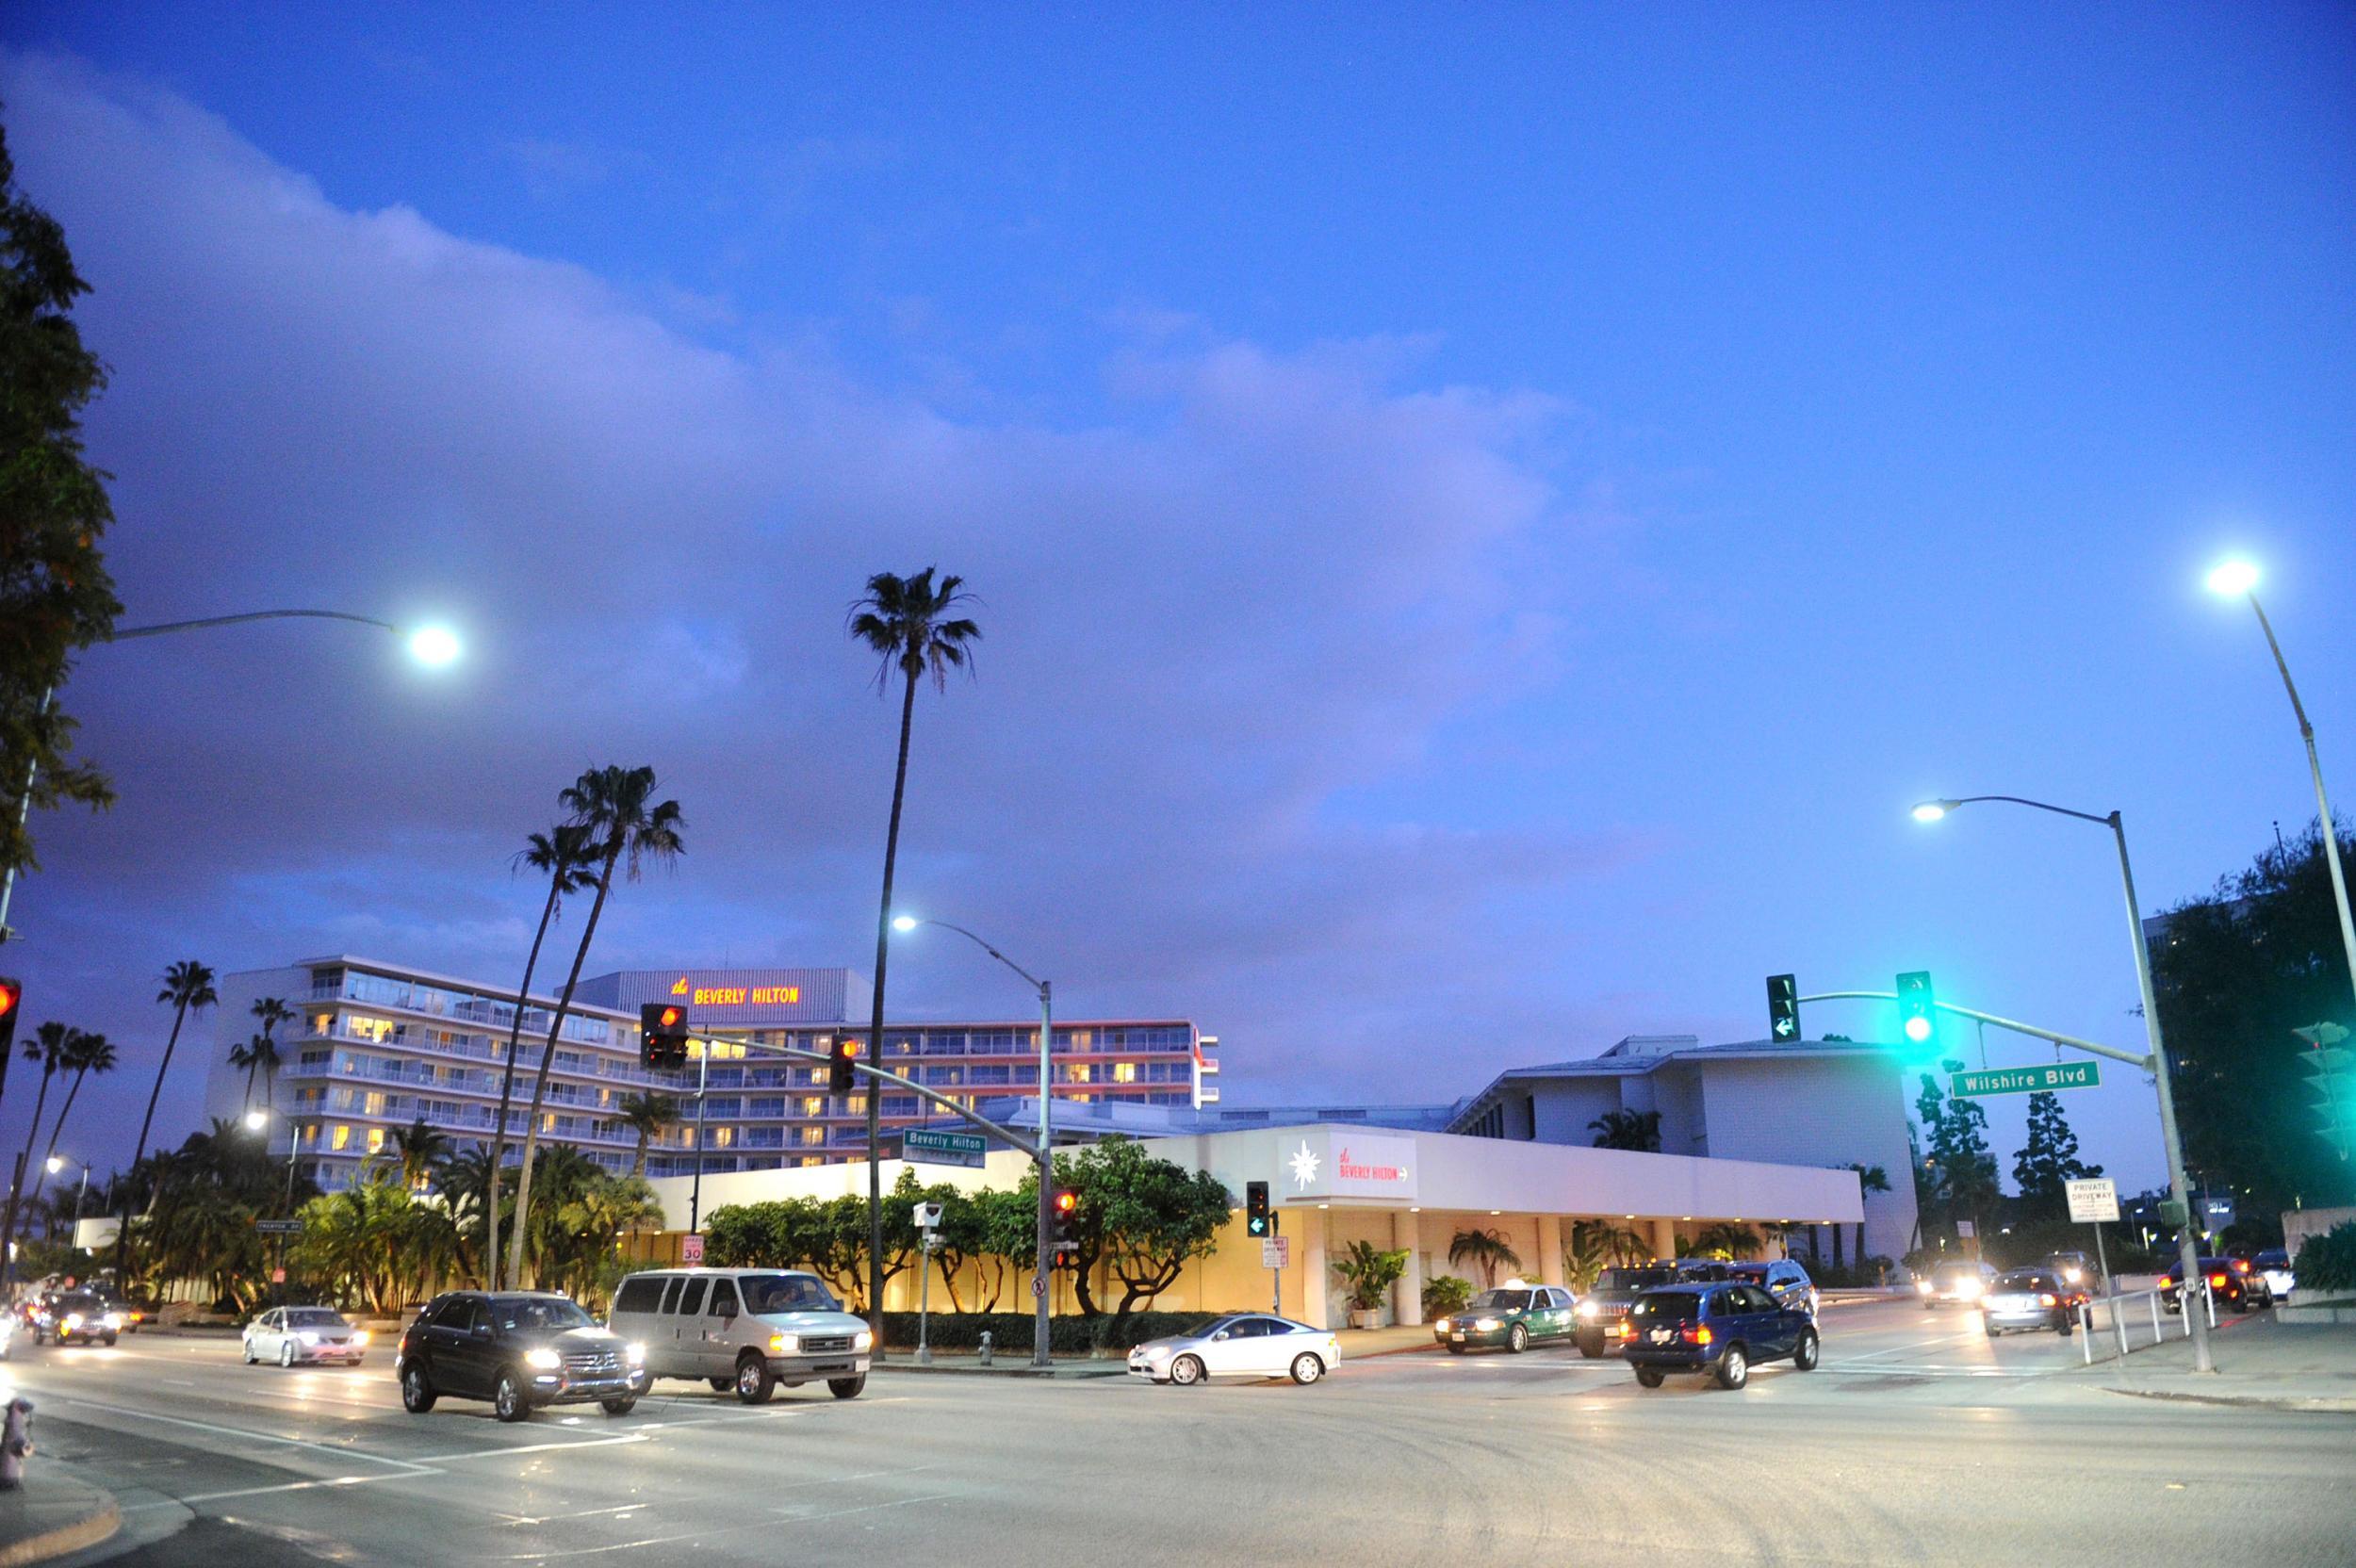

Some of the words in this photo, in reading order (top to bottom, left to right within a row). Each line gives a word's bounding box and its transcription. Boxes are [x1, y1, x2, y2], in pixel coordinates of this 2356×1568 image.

[671, 975, 688, 994] the
[694, 988, 745, 1004] BEVERLY
[752, 988, 798, 1004] HILTON
[1965, 1073, 2036, 1091] Wilshire
[2046, 1068, 2086, 1084] Blvd
[909, 1132, 947, 1148] Beverly
[952, 1136, 981, 1149] Hilton
[1339, 1165, 1369, 1179] BEVERLY
[1372, 1167, 1398, 1181] HILTON
[2073, 1183, 2107, 1191] PRIVATE
[2071, 1191, 2113, 1200] DRIVEWAY
[684, 1250, 701, 1259] 30
